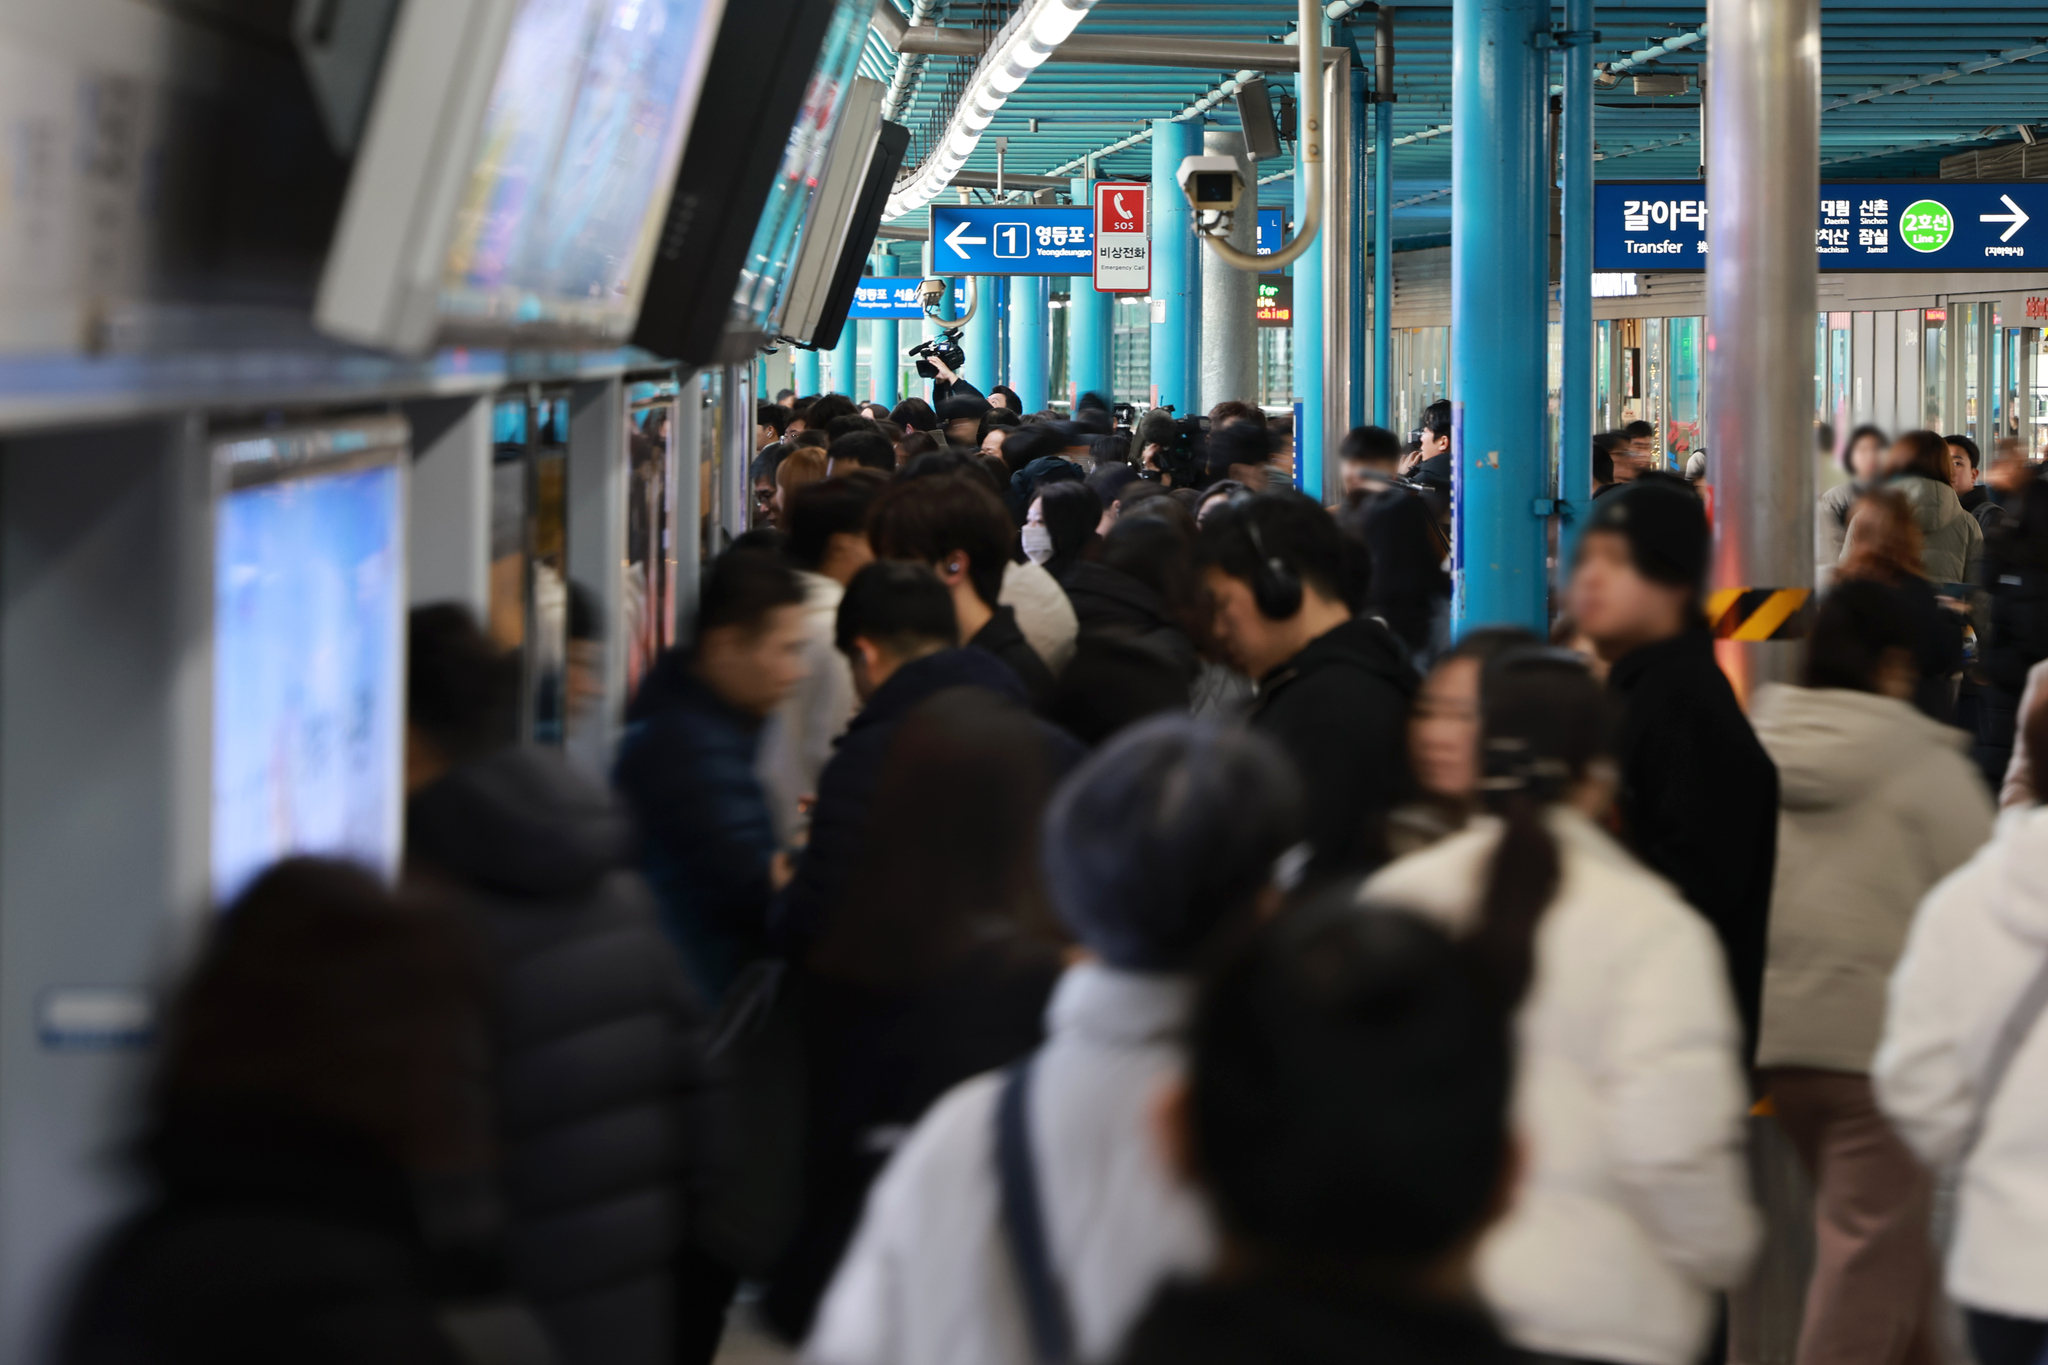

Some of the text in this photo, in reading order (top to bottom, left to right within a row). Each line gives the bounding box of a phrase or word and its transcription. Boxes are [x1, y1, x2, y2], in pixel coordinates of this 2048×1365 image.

[1820, 199, 1889, 217] 대림 신촌
[1623, 200, 1709, 231] 갈아타
[1905, 214, 1948, 231] 2호선
[1114, 222, 1134, 230] SOS
[1002, 227, 1016, 254] 1
[1035, 226, 1085, 246] 영등포
[1859, 228, 1889, 246] 잠실
[1913, 234, 1943, 244] Line 2
[1036, 248, 1092, 257] Yeongdeungpo
[1100, 247, 1146, 259] 비상전화
[1624, 239, 1683, 254] Transfer
[1984, 246, 2025, 257] (지하역사)
[894, 288, 917, 301] 서울
[1259, 284, 1278, 296] for
